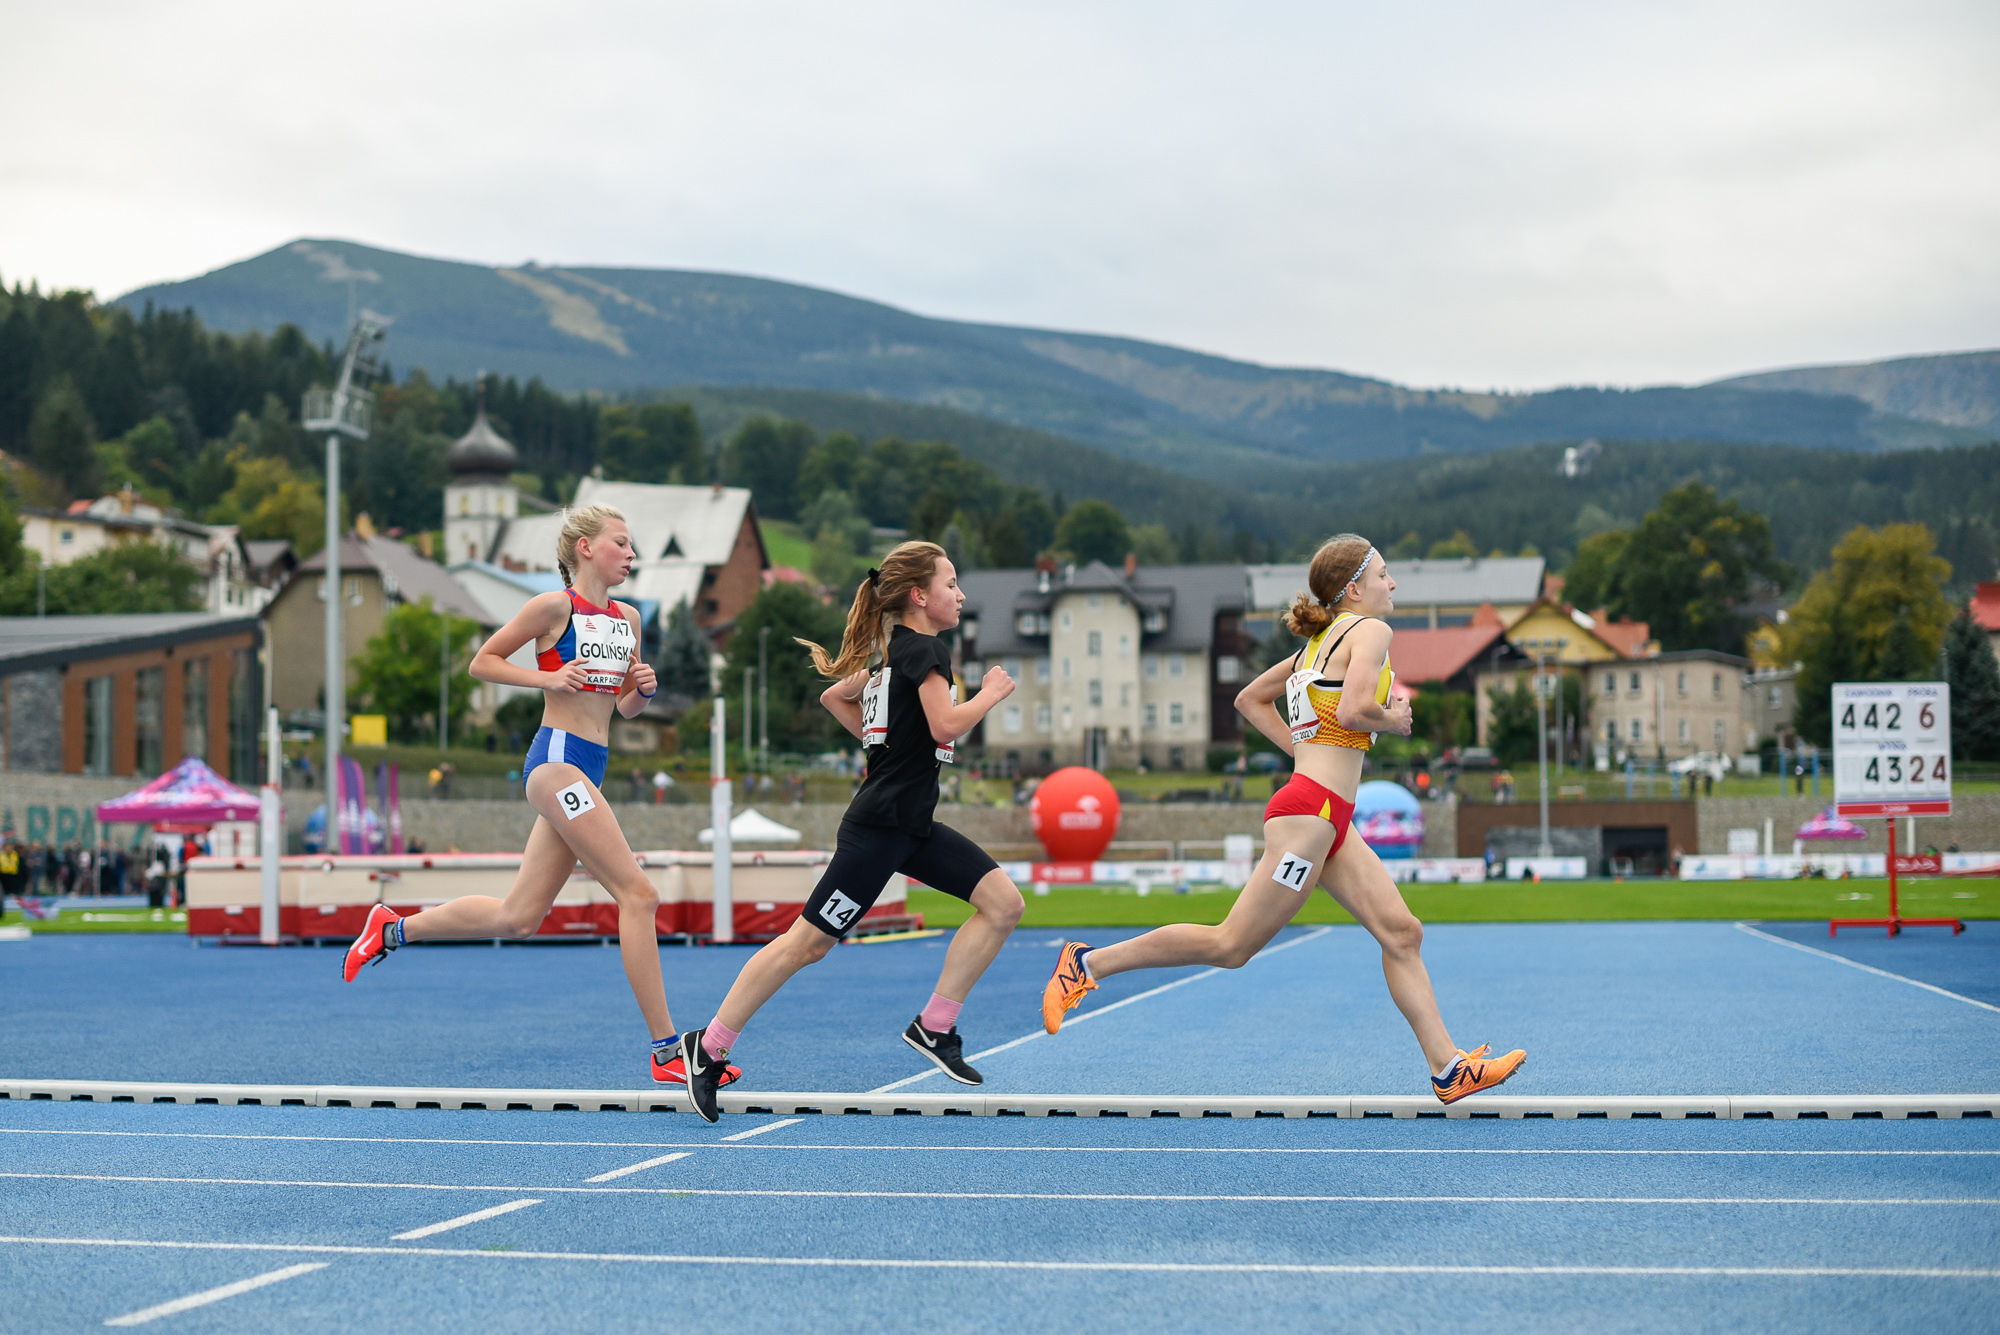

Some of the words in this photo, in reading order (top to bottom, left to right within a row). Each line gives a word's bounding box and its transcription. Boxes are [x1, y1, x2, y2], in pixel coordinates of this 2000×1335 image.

[609, 619, 629, 637] 747
[1841, 702, 1901, 730] 442
[1919, 702, 1936, 729] 6
[1282, 860, 1308, 886] 11
[826, 898, 856, 926] 14
